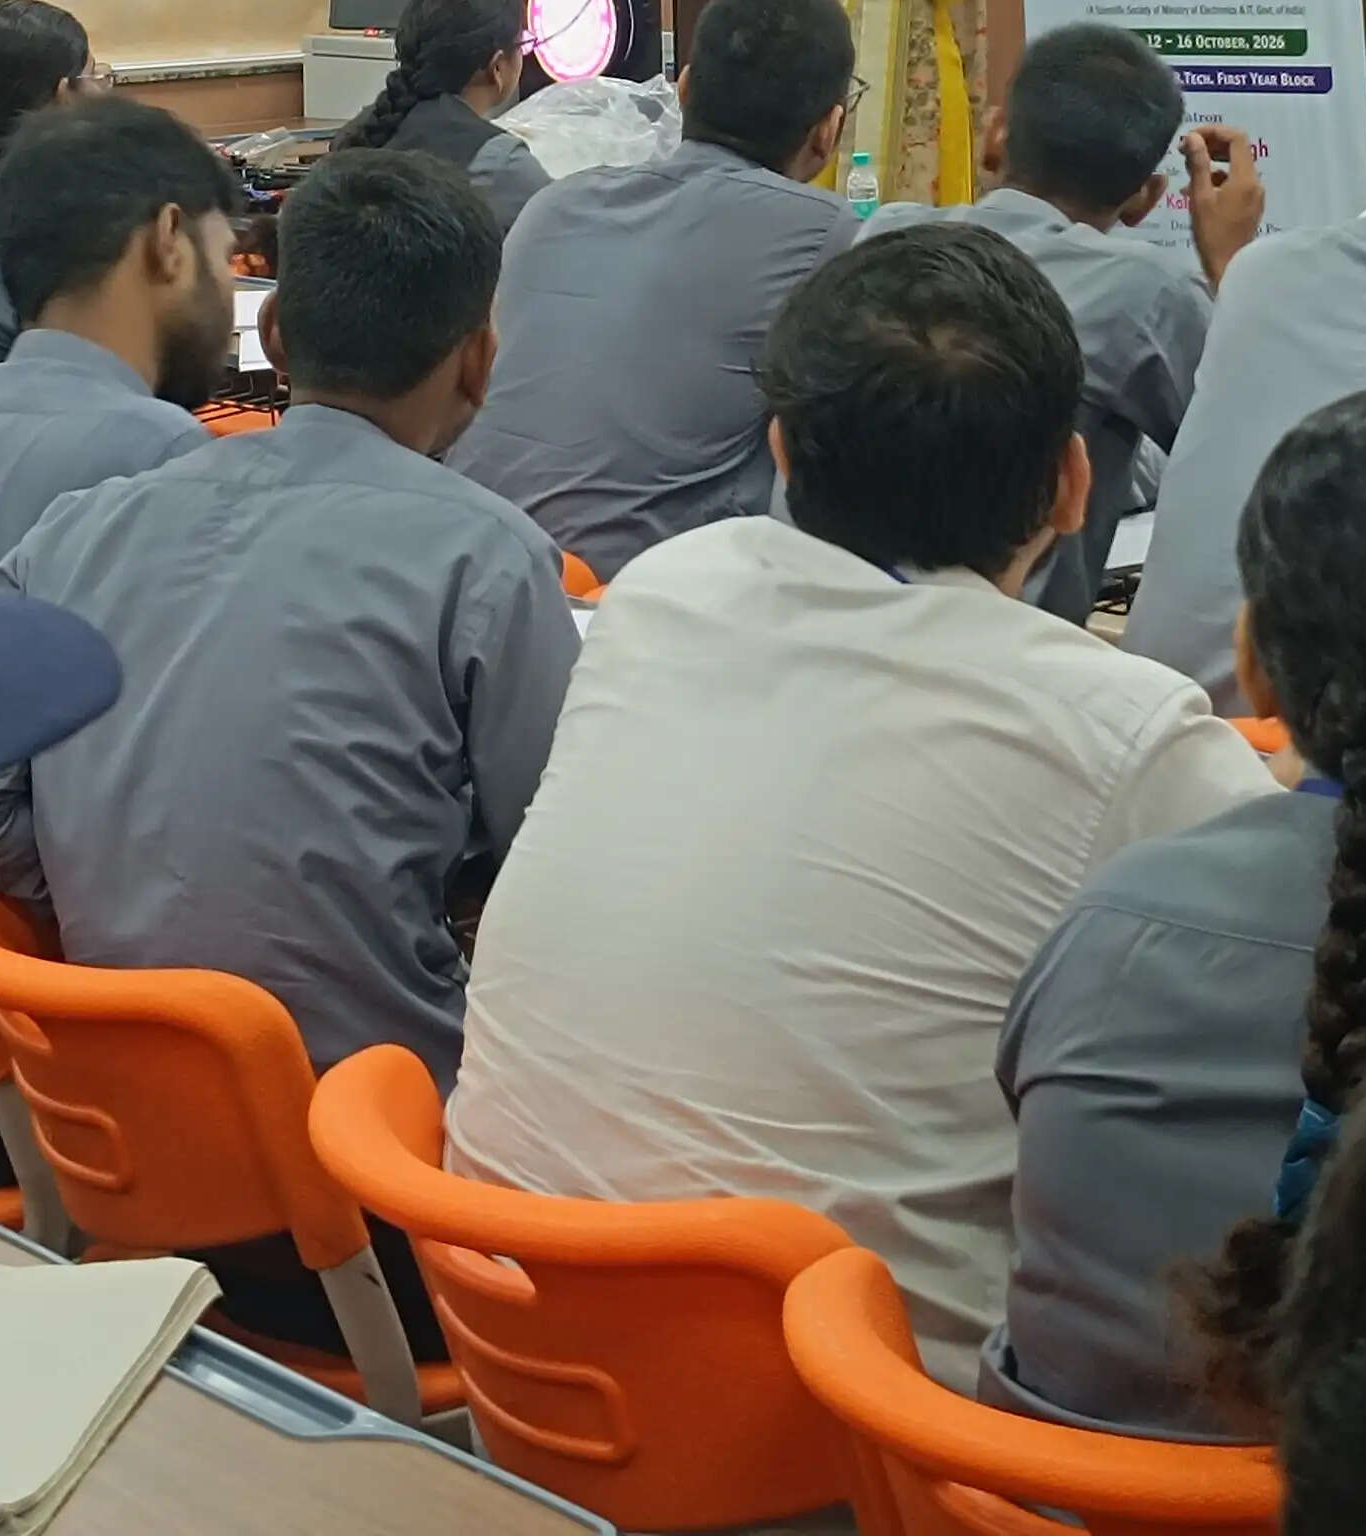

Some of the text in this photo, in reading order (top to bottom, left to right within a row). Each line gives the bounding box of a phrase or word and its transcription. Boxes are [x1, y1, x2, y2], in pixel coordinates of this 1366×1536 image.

[1146, 34, 1163, 48] 12
[1177, 34, 1193, 49] 16
[1252, 34, 1285, 49] 2026
[1185, 112, 1223, 123] atron
